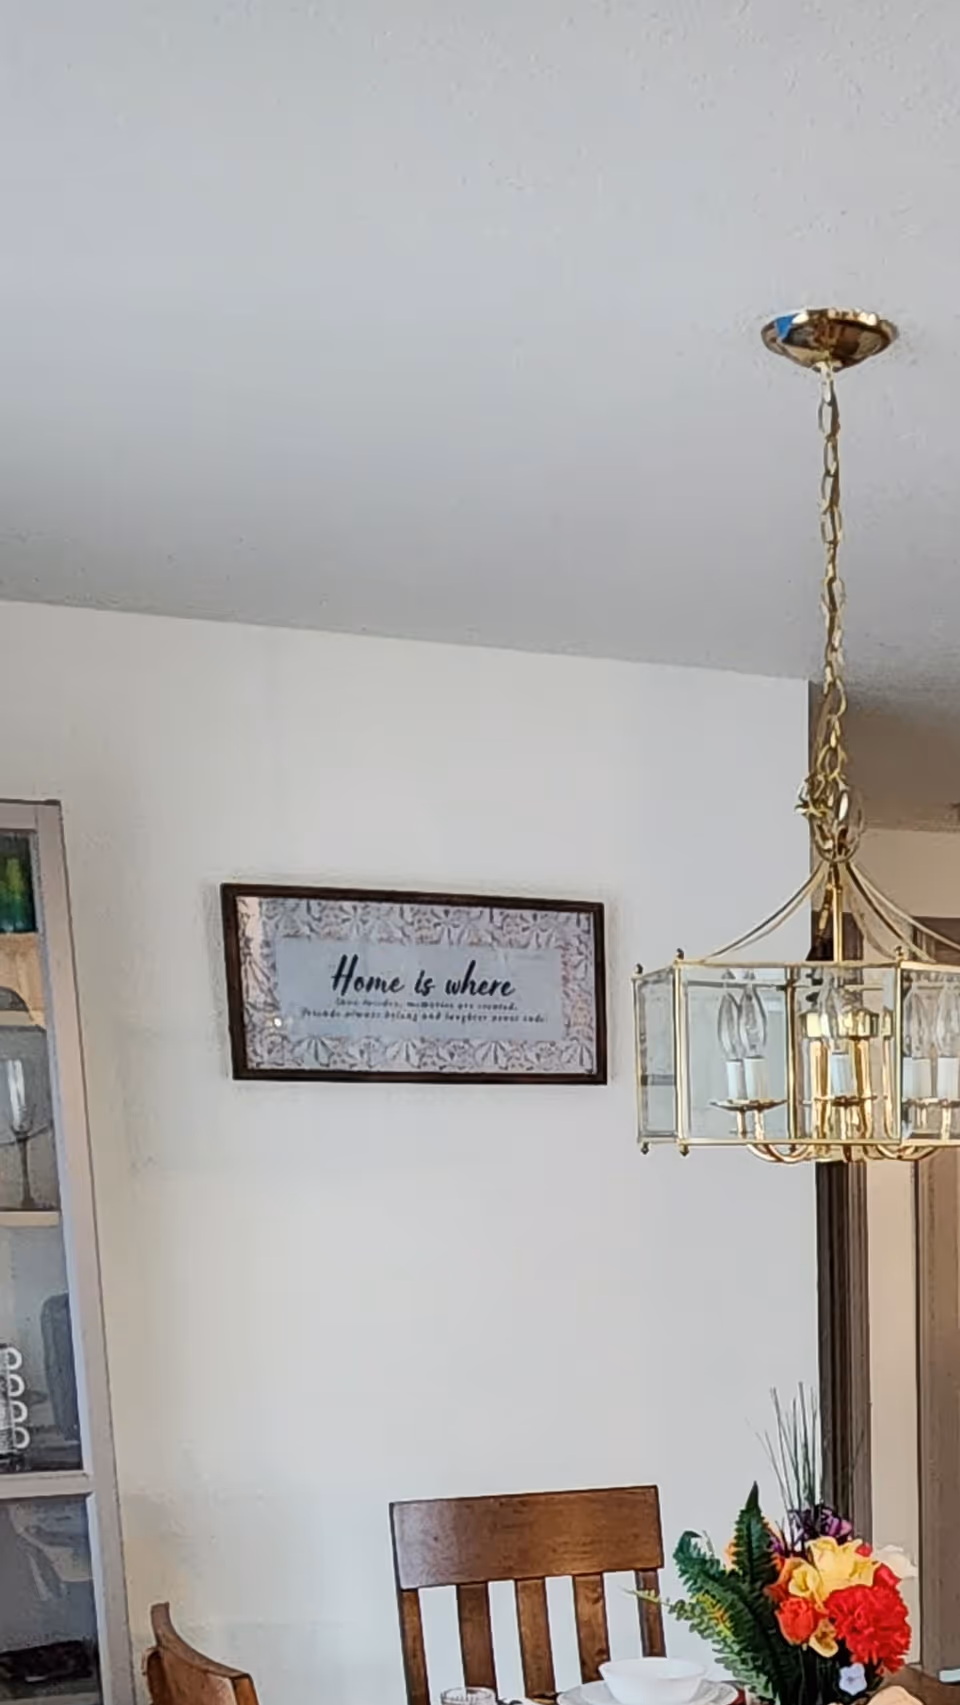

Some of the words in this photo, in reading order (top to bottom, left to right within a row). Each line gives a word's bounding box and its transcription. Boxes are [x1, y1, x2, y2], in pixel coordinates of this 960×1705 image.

[331, 954, 405, 996] Home
[414, 970, 435, 997] is
[445, 960, 516, 996] where
